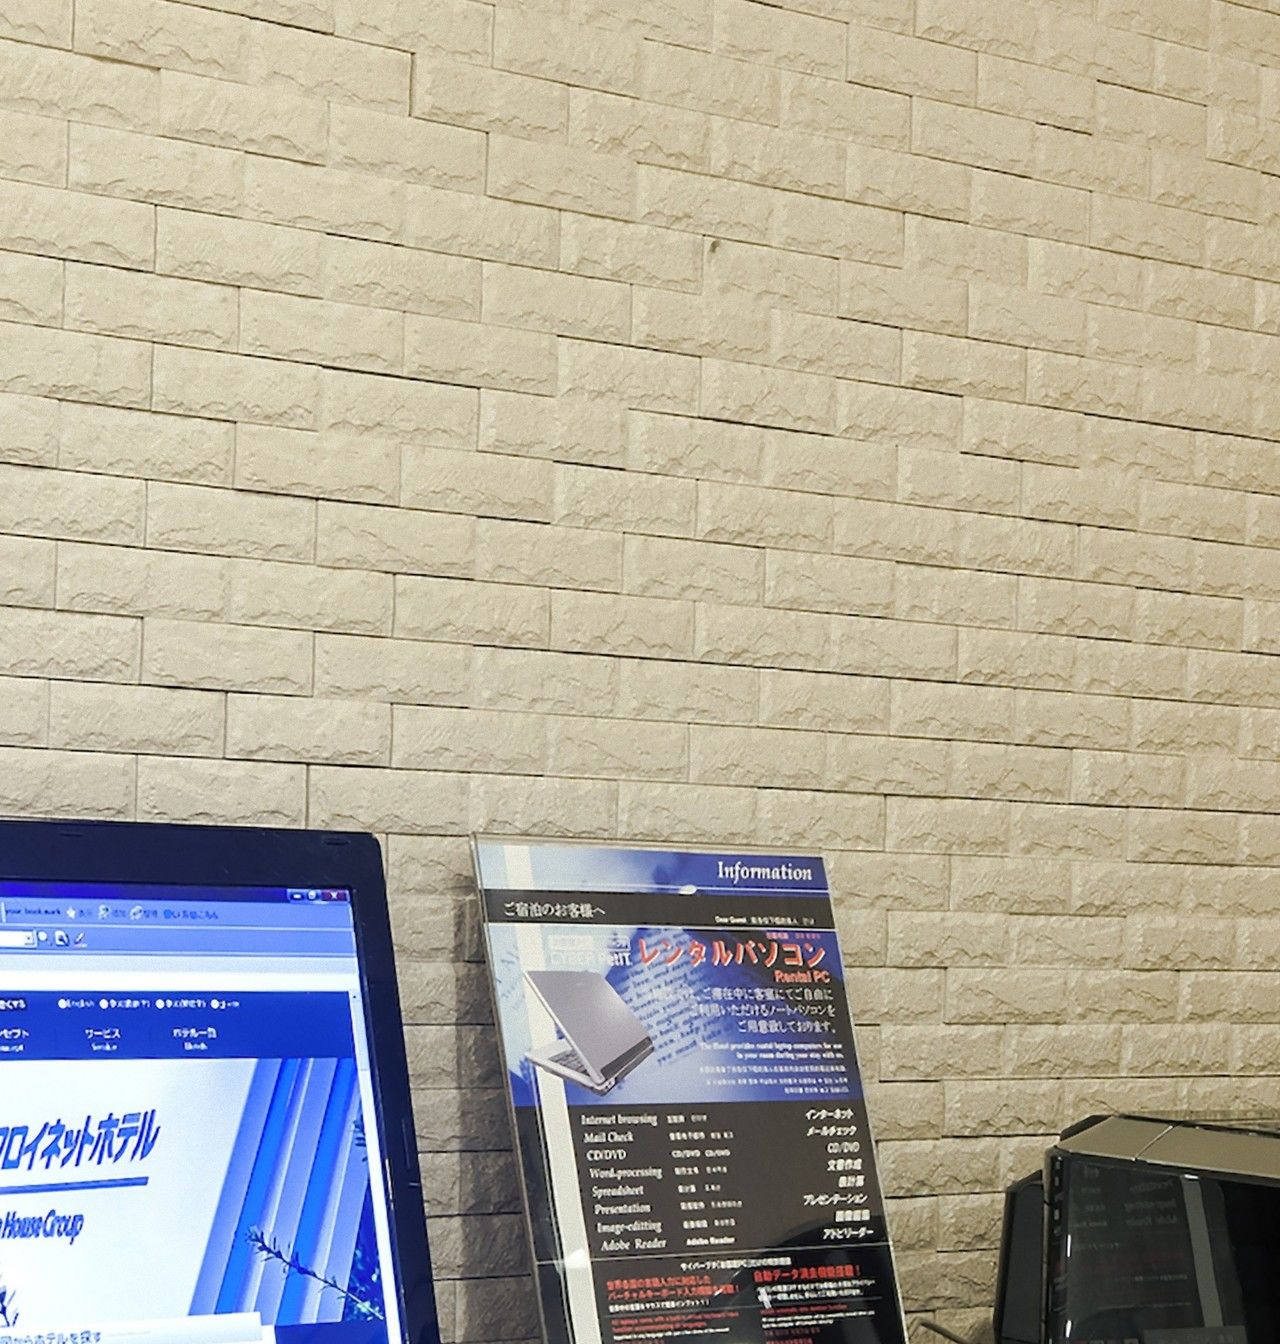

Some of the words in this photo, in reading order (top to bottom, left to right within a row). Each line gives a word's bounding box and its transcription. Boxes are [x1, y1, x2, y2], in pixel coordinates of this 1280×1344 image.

[717, 860, 812, 884] Information
[504, 901, 606, 918] ご宿泊のお客様へ
[638, 937, 826, 969] レンタルパソコン
[774, 969, 812, 984] Rental
[812, 970, 831, 984] PC
[43, 1209, 85, 1246] Group
